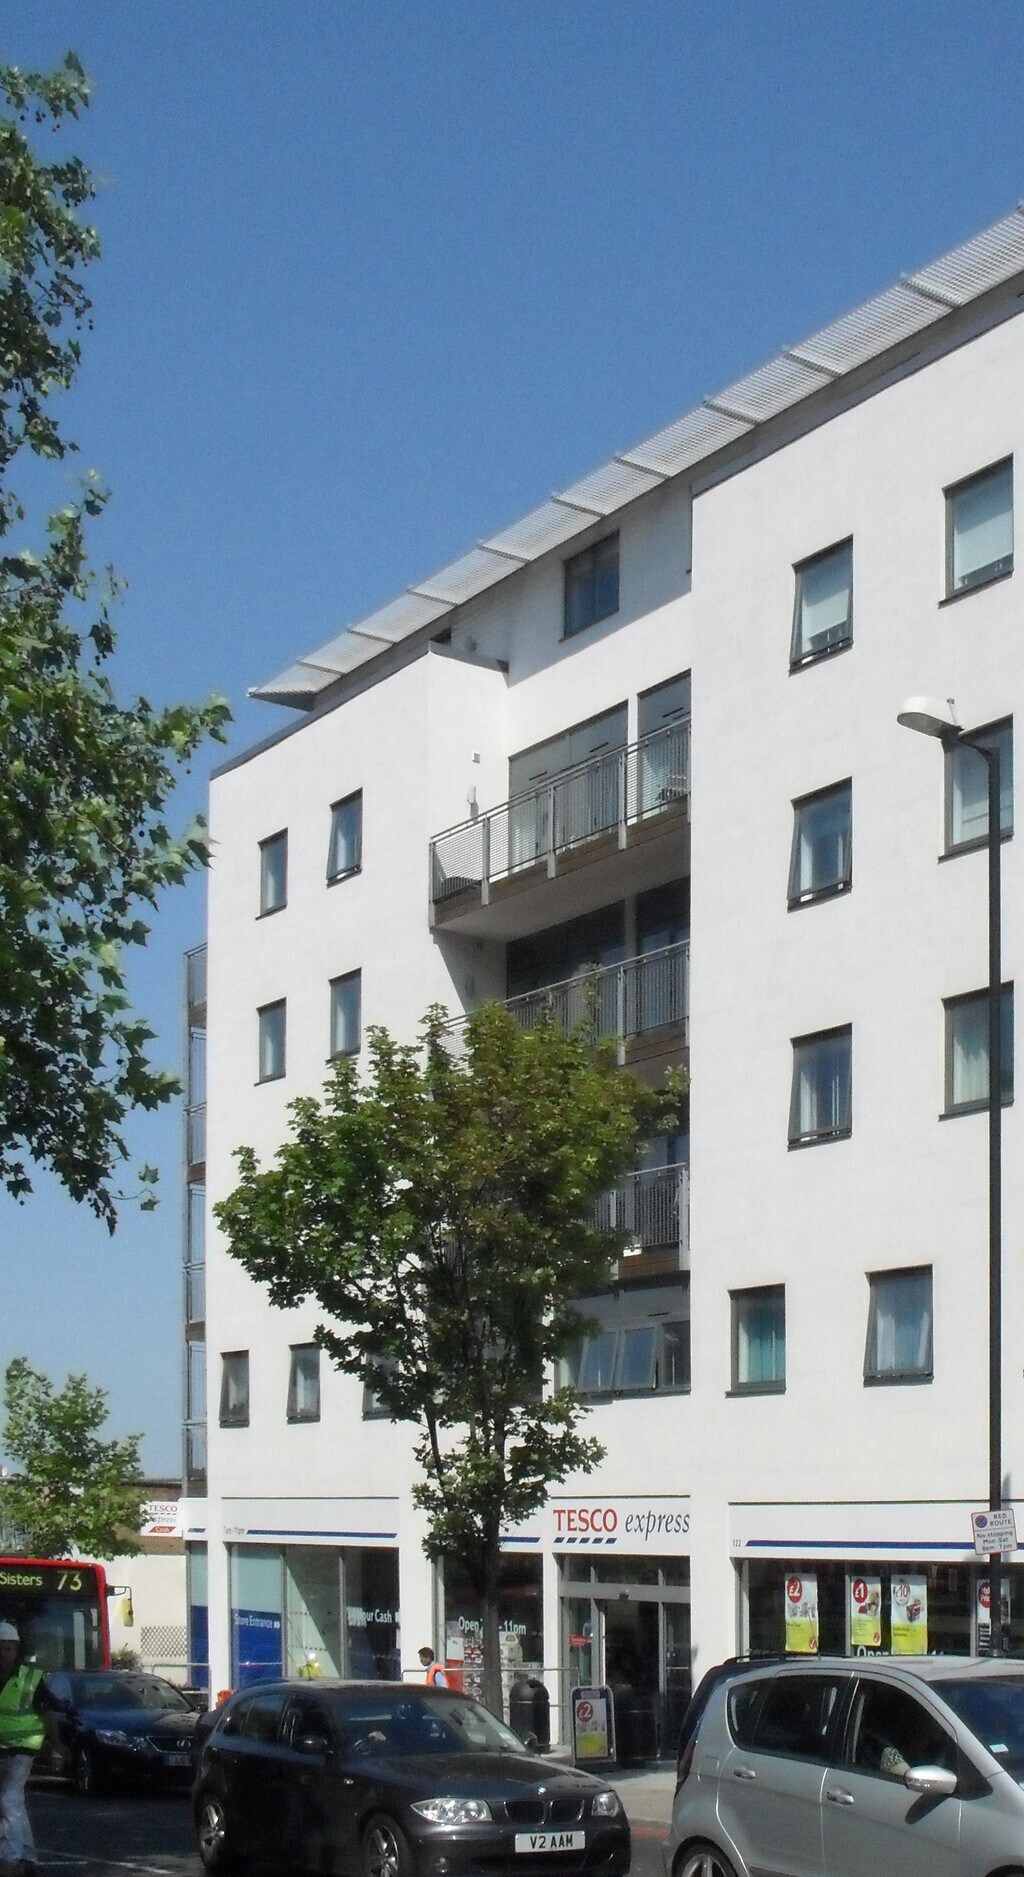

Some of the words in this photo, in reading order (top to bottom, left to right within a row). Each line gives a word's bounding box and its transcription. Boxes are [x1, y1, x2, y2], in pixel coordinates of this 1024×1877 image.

[149, 1504, 178, 1512] TESCO
[553, 1508, 618, 1533] TESCO
[625, 1510, 690, 1541] express
[990, 1519, 1012, 1527] ROUTE
[987, 1530, 1014, 1539] stopping
[0, 1571, 43, 1586] Sisters
[57, 1569, 82, 1591] 73
[855, 1582, 865, 1599] £1
[250, 1614, 273, 1629] Entrance
[374, 1608, 392, 1623] Cash
[458, 1615, 480, 1634] Open
[530, 1835, 546, 1849] V2
[550, 1833, 573, 1848] AAM
